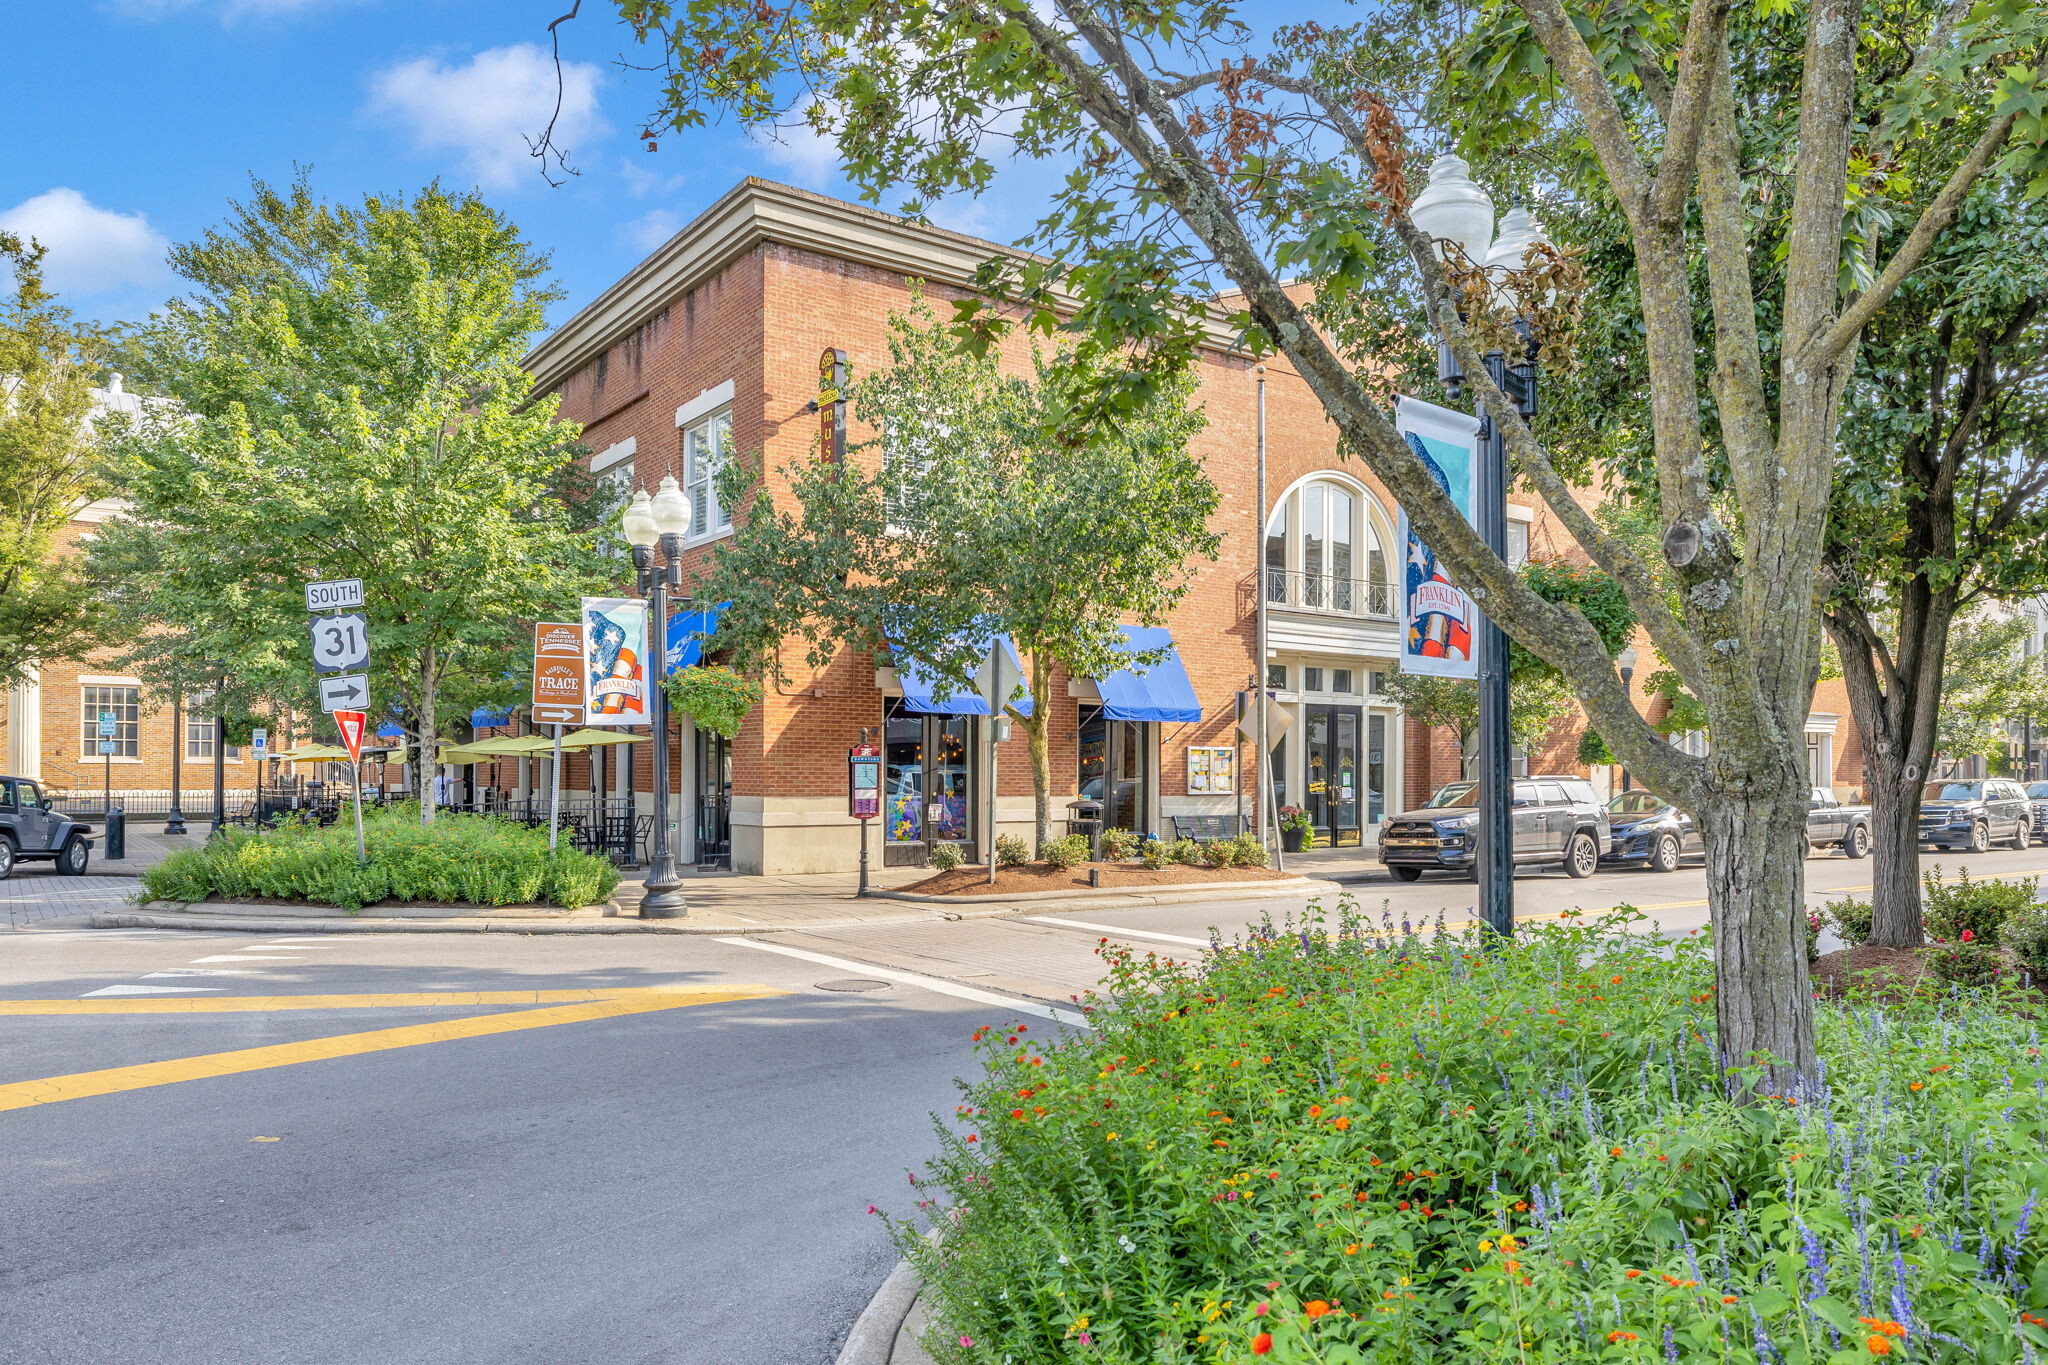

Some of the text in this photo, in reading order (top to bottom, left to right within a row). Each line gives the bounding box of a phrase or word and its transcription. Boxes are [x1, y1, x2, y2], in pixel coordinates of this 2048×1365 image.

[310, 585, 358, 604] SOUTH
[1418, 585, 1461, 607] FRANKLIN
[324, 625, 356, 657] 31
[539, 637, 582, 646] TENNESSEE
[539, 676, 579, 690] TRACE
[598, 680, 635, 691] FRANKLIN
